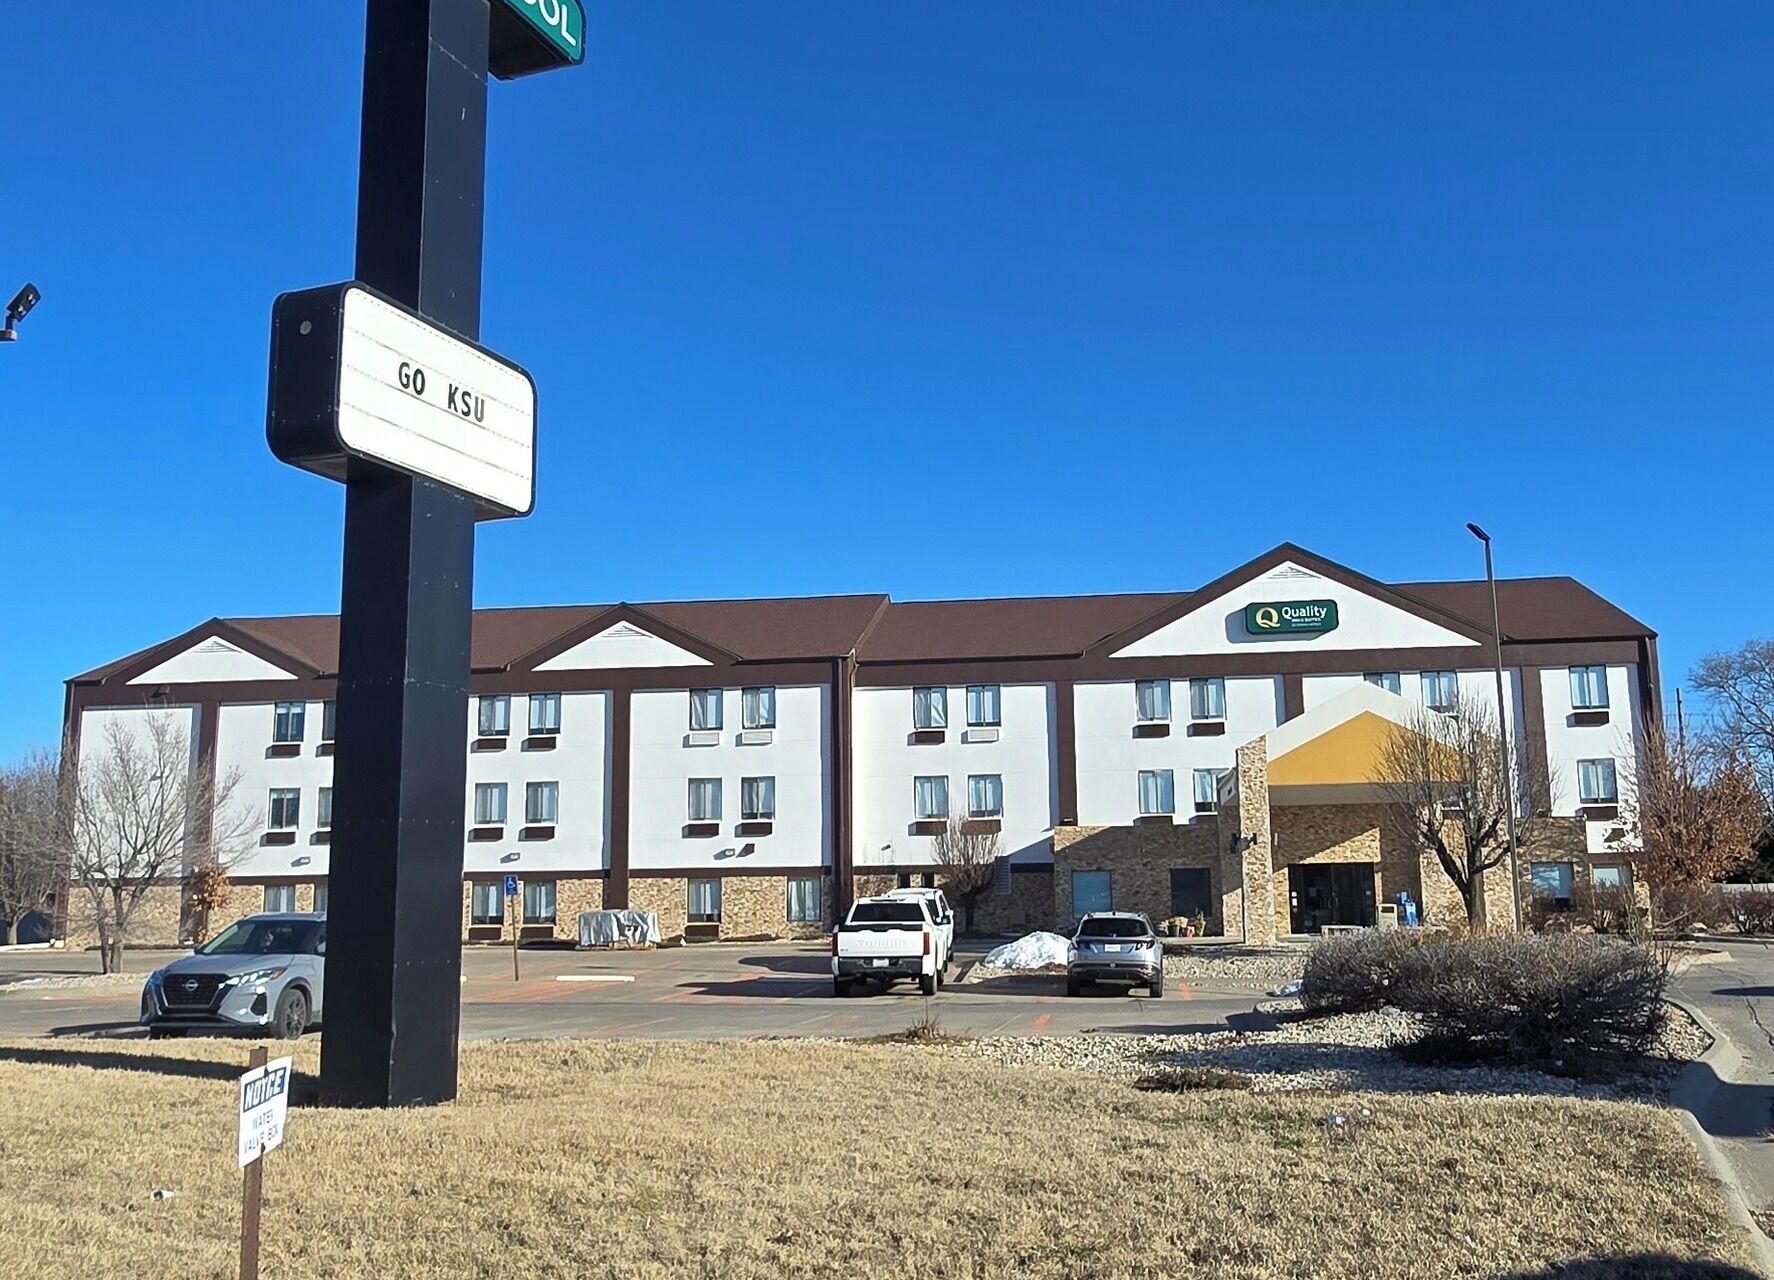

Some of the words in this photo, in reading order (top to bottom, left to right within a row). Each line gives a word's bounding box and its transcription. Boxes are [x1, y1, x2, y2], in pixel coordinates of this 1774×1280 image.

[398, 361, 426, 396] GO
[447, 383, 485, 423] KSU
[1281, 605, 1327, 620] Quality
